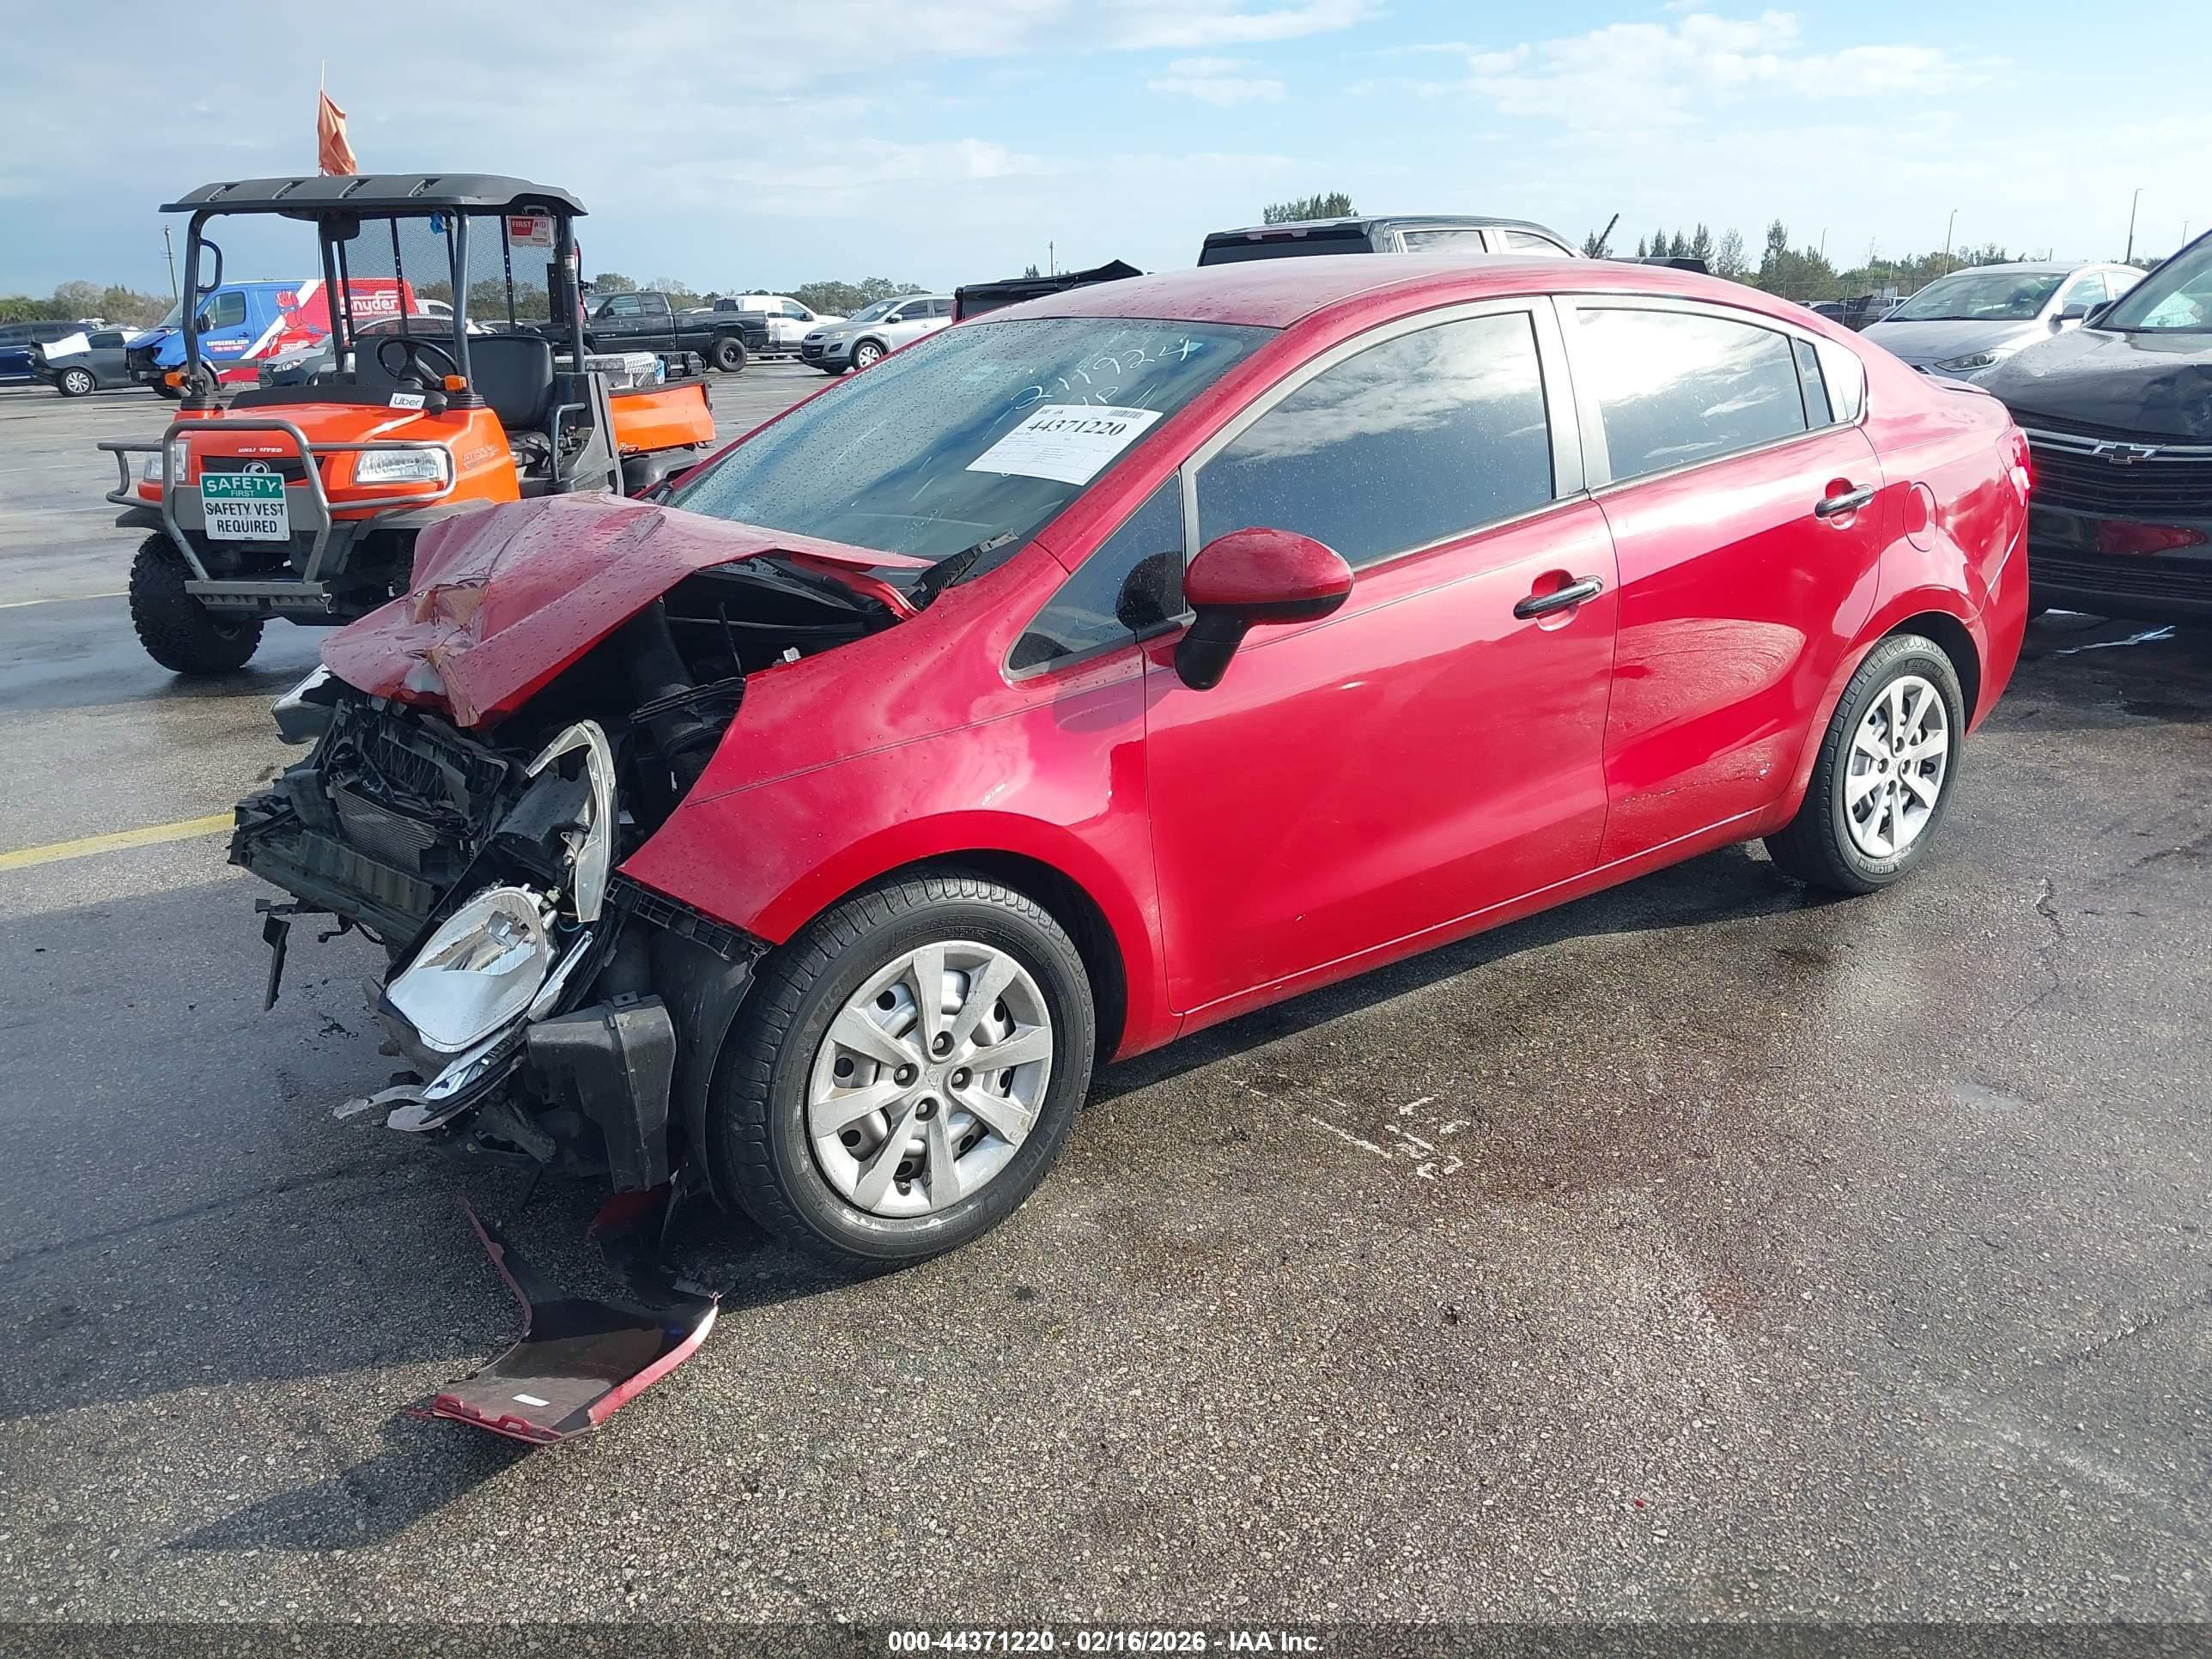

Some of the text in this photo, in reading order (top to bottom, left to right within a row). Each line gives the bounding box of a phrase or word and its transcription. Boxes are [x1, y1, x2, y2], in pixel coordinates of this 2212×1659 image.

[393, 396, 420, 406] Uber
[1027, 419, 1127, 436] 44371220
[206, 477, 277, 493] SAFETY
[205, 502, 285, 516] SAFETY VEST
[216, 520, 277, 533] REQUIRED
